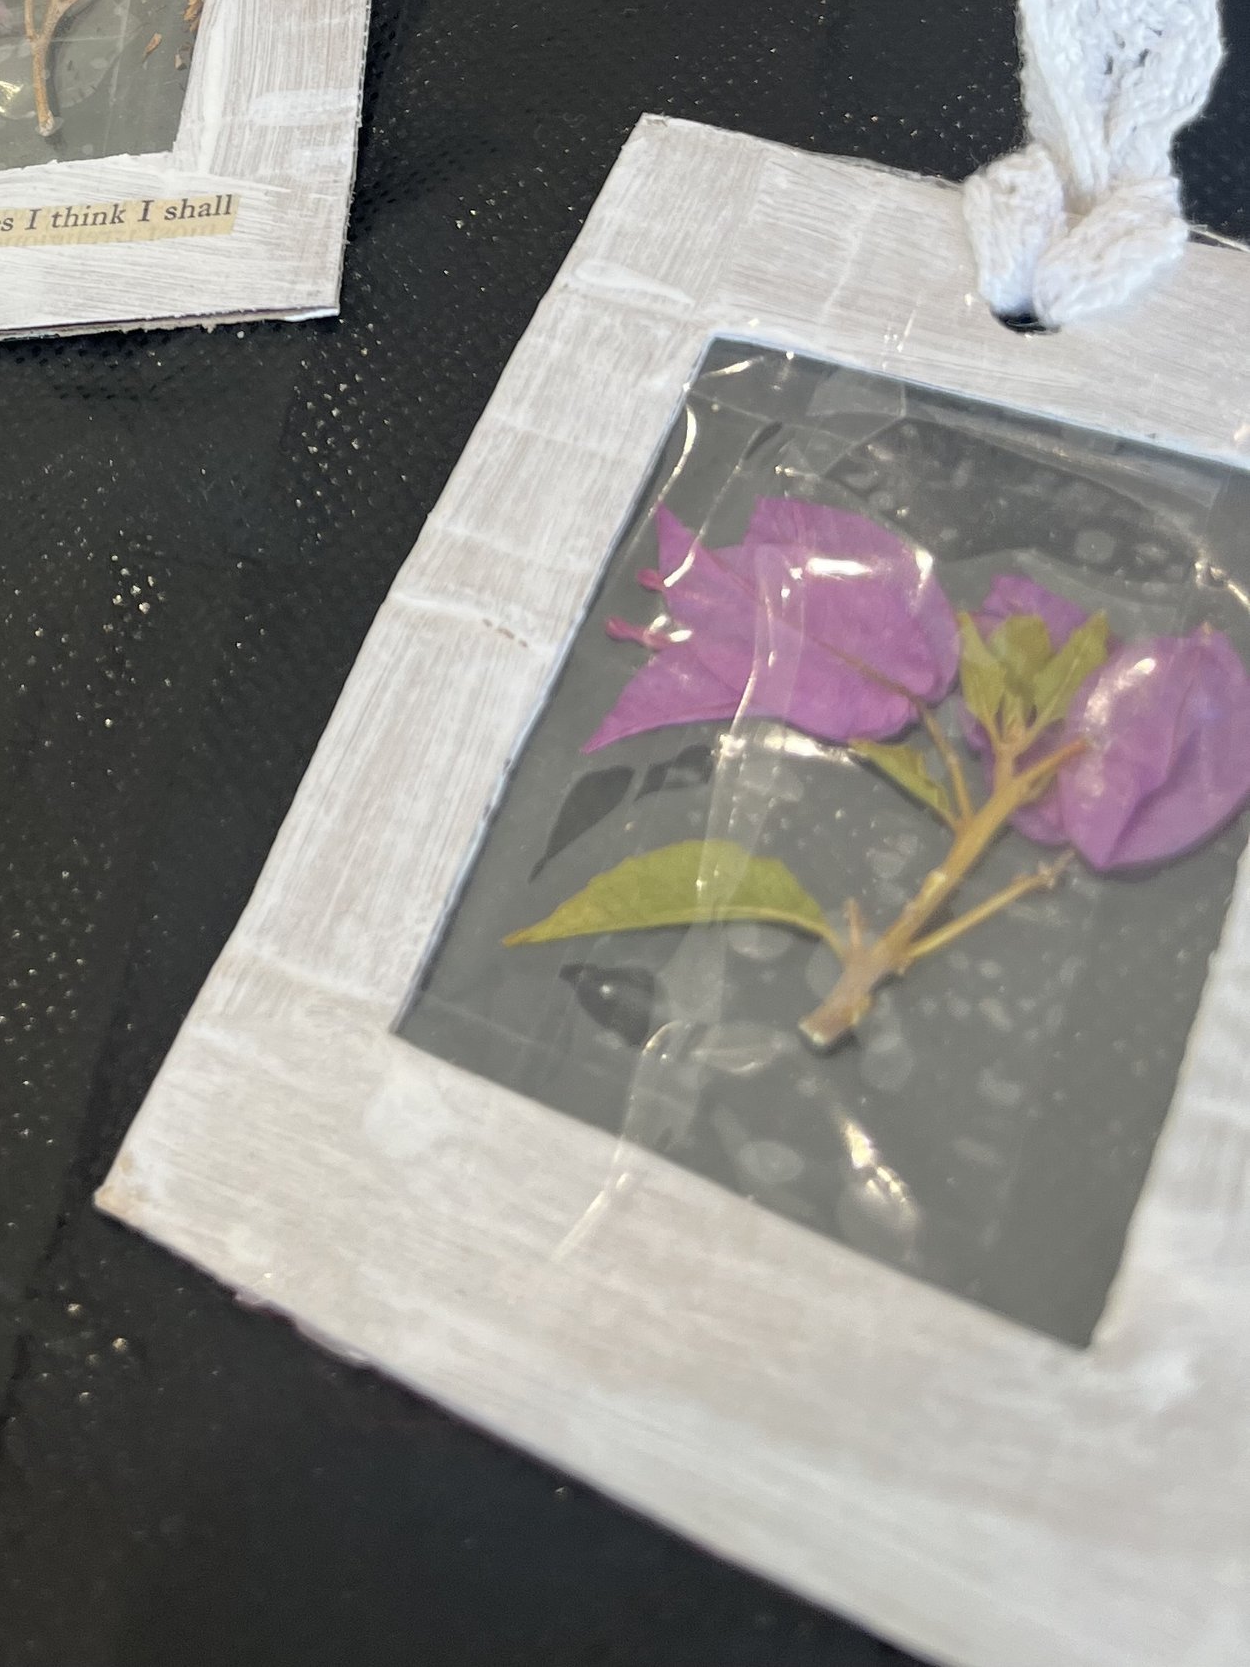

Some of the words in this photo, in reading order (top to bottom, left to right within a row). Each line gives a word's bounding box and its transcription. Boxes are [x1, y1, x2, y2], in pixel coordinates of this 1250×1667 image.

[24, 208, 42, 230] I
[51, 203, 126, 228] think
[137, 199, 155, 222] I
[164, 194, 232, 221] shall
